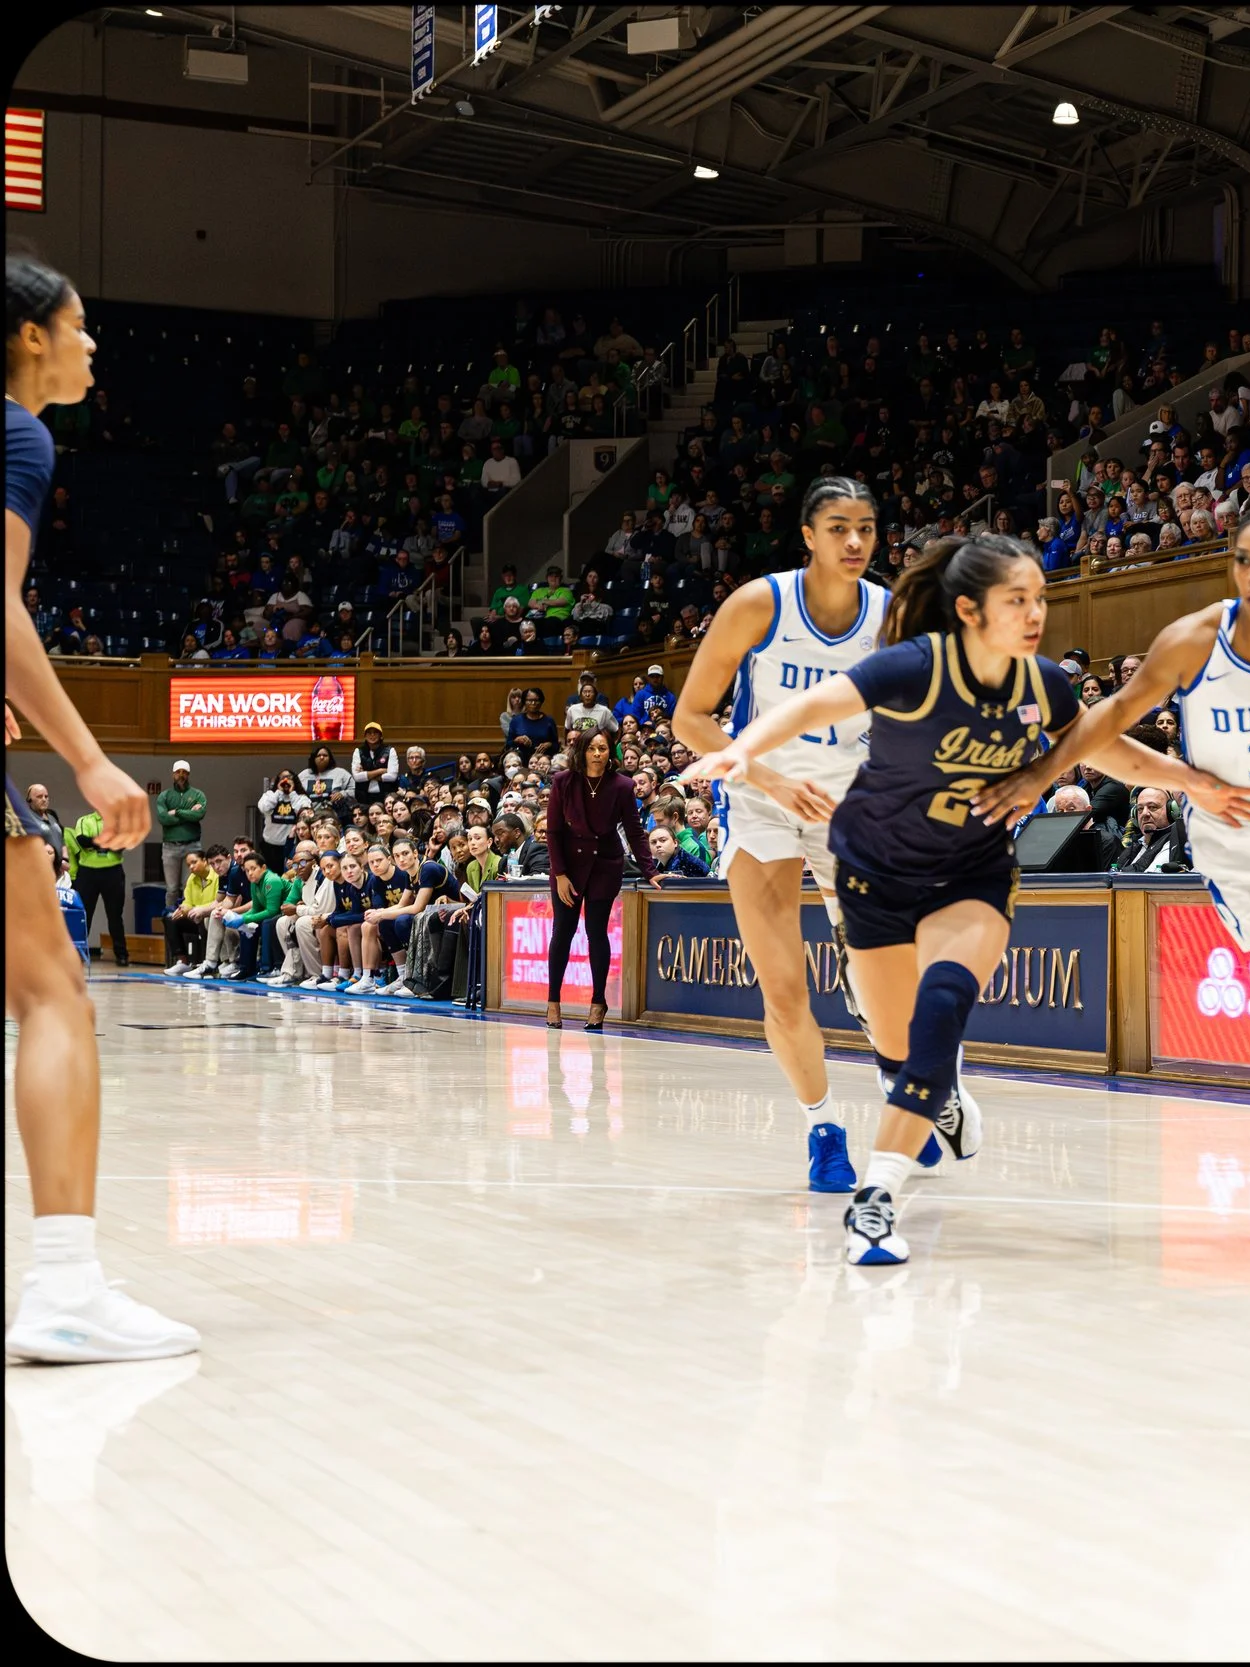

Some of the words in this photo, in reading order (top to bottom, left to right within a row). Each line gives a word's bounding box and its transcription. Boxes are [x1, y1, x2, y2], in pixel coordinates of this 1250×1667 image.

[780, 662, 845, 691] DU
[179, 693, 224, 714] FAN
[228, 693, 303, 714] WORK
[179, 715, 193, 729] IS
[194, 714, 257, 729] THIRSTY
[255, 713, 303, 729] WORK
[934, 726, 1028, 769] Irish
[512, 917, 544, 955] FAN
[657, 933, 759, 989] CAMERO
[978, 946, 1084, 1010] DIUM
